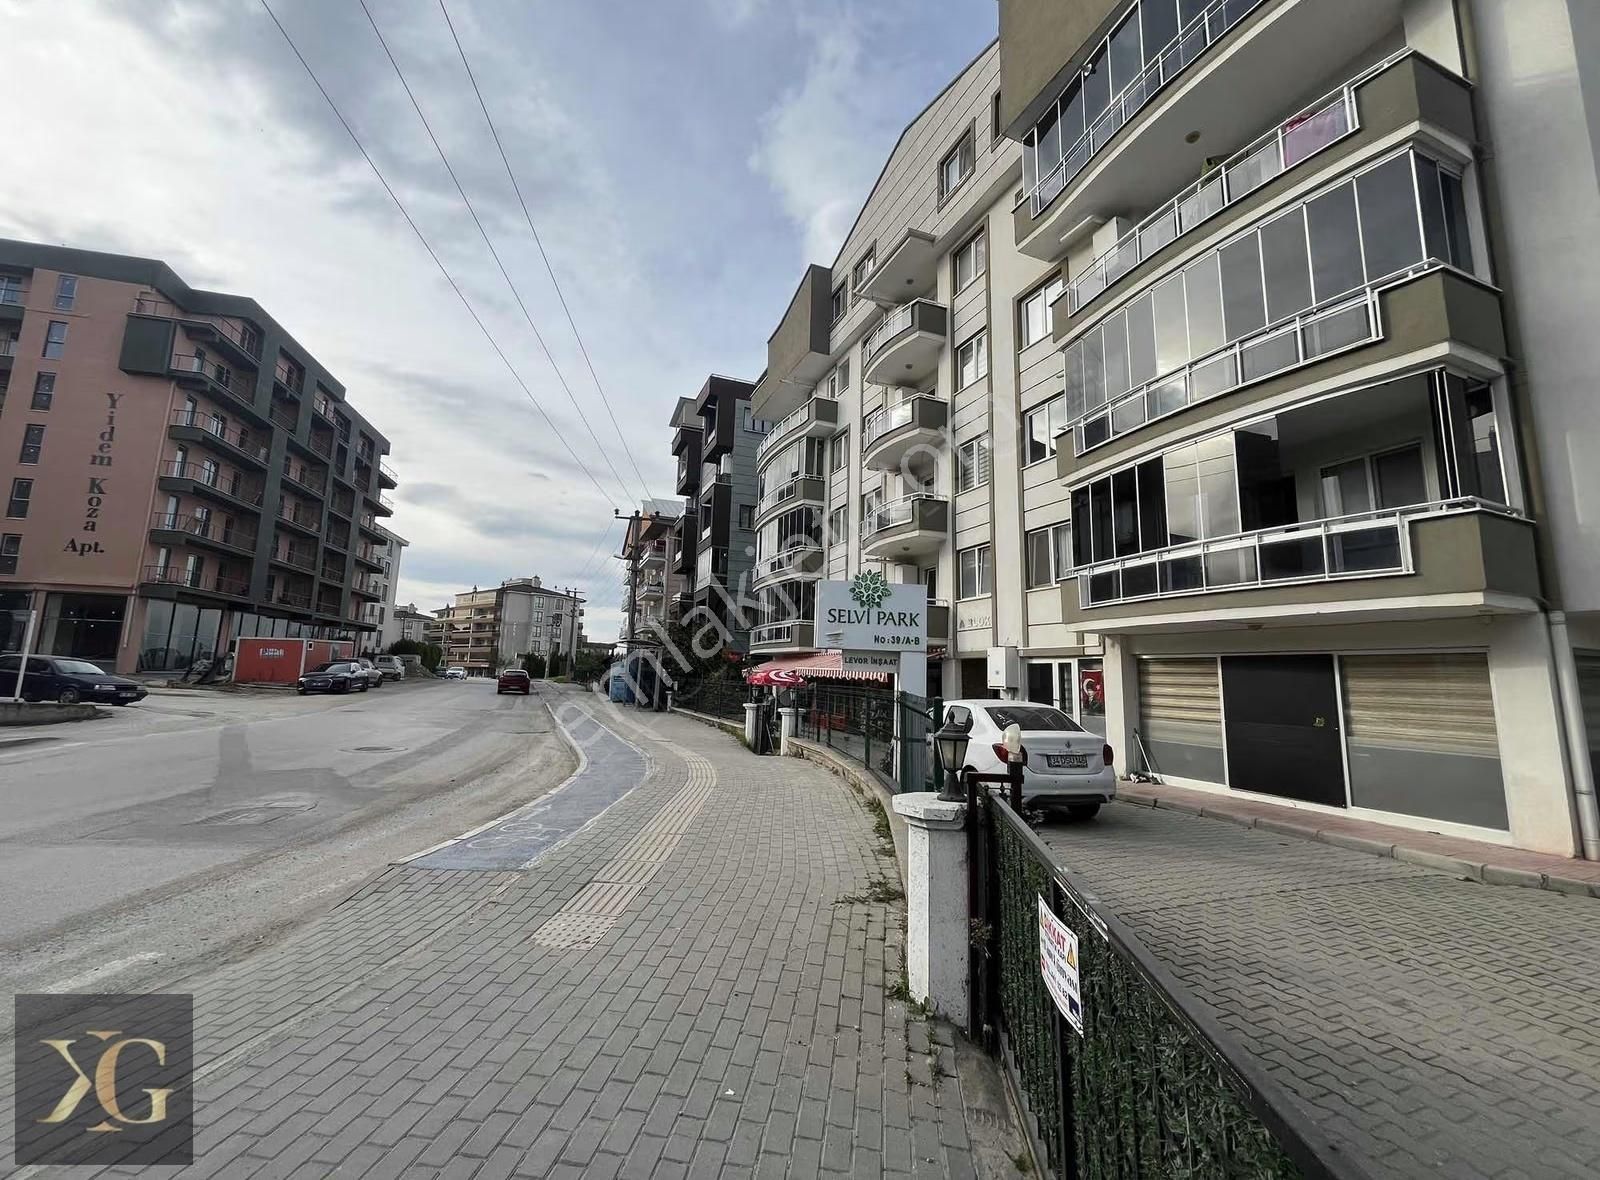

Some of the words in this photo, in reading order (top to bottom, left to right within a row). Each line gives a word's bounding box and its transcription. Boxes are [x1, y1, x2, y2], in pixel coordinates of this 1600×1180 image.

[90, 393, 124, 466] Yidem
[83, 477, 108, 532] Koza
[63, 537, 105, 557] Apt.
[827, 608, 870, 625] SELVİ
[877, 611, 920, 627] PARK
[844, 656, 870, 666] LEVOR
